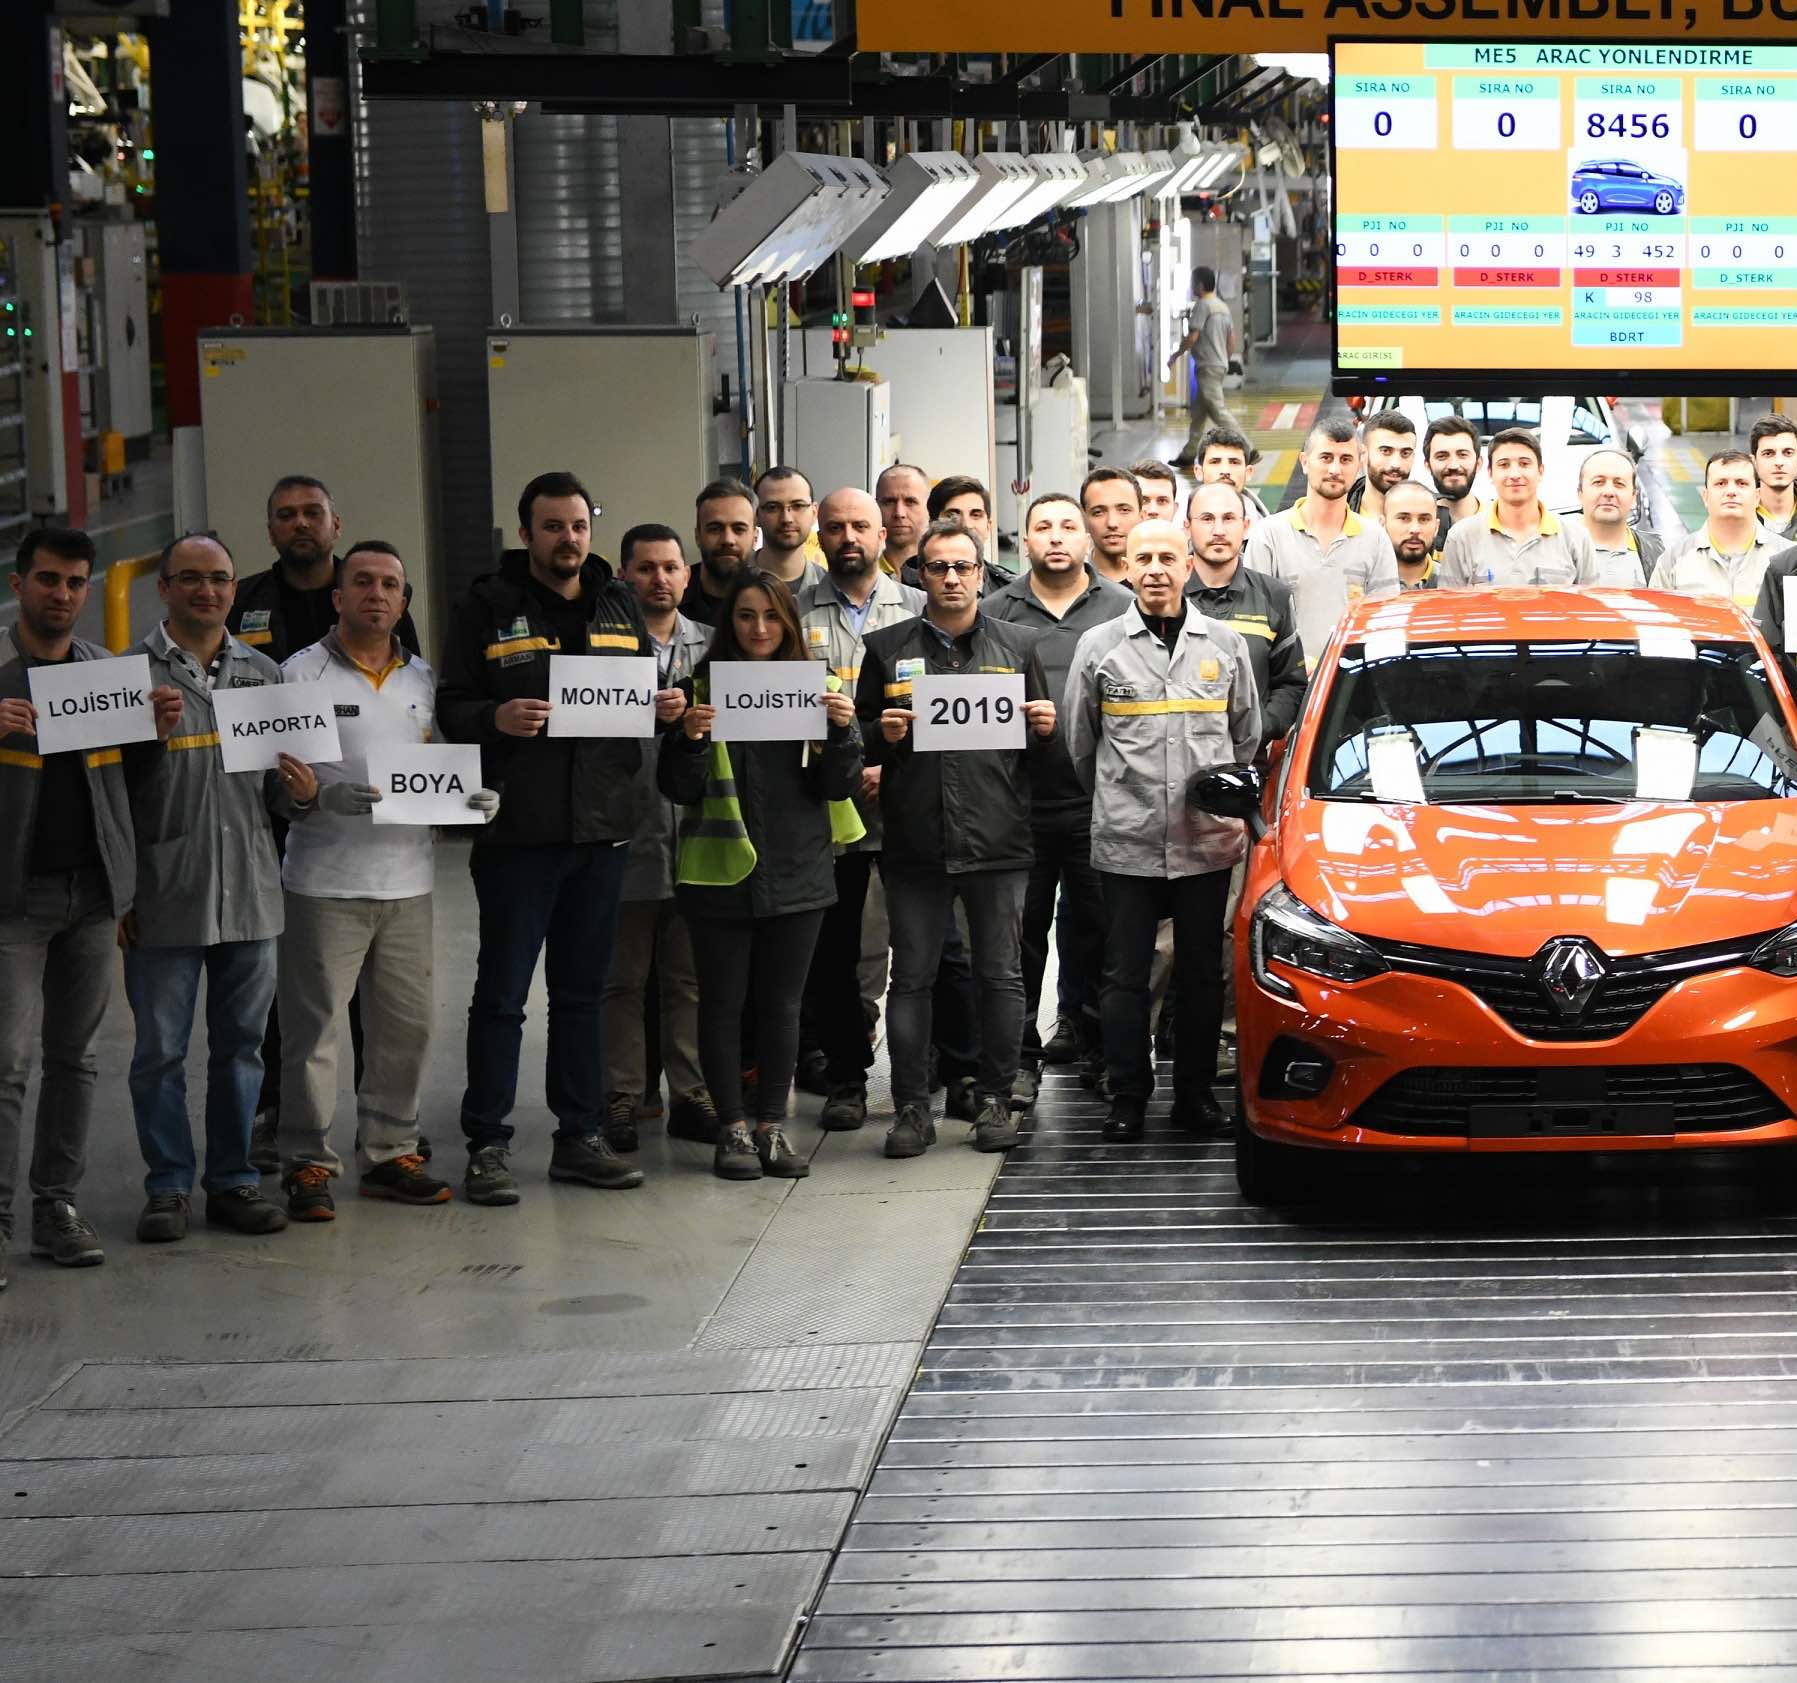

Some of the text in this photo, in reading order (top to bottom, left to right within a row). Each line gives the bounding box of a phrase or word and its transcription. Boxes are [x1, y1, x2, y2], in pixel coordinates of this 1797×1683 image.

[1475, 48, 1753, 65] ME5 ARAC YONLENDIRME
[1355, 82, 1410, 92] SIRA NO
[1480, 84, 1534, 93] SIRA NO
[1601, 84, 1655, 94] SIRA NO
[1721, 85, 1775, 95] SIRA NO
[1374, 111, 1393, 136] 0
[1497, 112, 1516, 137] 0
[1586, 113, 1670, 138] 8456
[1739, 114, 1757, 139] 0
[1363, 221, 1406, 230] PJI NO
[1486, 222, 1529, 231] PJI NO
[1606, 223, 1649, 231] PJI NO
[1726, 223, 1769, 232] PJI NO
[1369, 243, 1379, 257] 0
[1413, 244, 1423, 257] 0
[1460, 244, 1544, 258] 0 0 0
[1574, 245, 1674, 258] 49 3 452
[1701, 245, 1784, 258] 0 0 0
[1358, 272, 1413, 283] D_STERK
[1480, 272, 1534, 283] D_STERK
[1600, 273, 1654, 284] D_STERK
[1720, 274, 1773, 284] D_STERK
[1586, 292, 1594, 303] K
[1634, 292, 1652, 303] 98
[1610, 332, 1645, 342] BDRT
[49, 688, 145, 718] LOJİSTİK
[561, 688, 651, 706] MONTAJ
[725, 689, 817, 709] LOJİSTİK
[930, 697, 1014, 725] 2019
[232, 714, 327, 738] KAPORTA
[391, 774, 465, 794] BOYA
